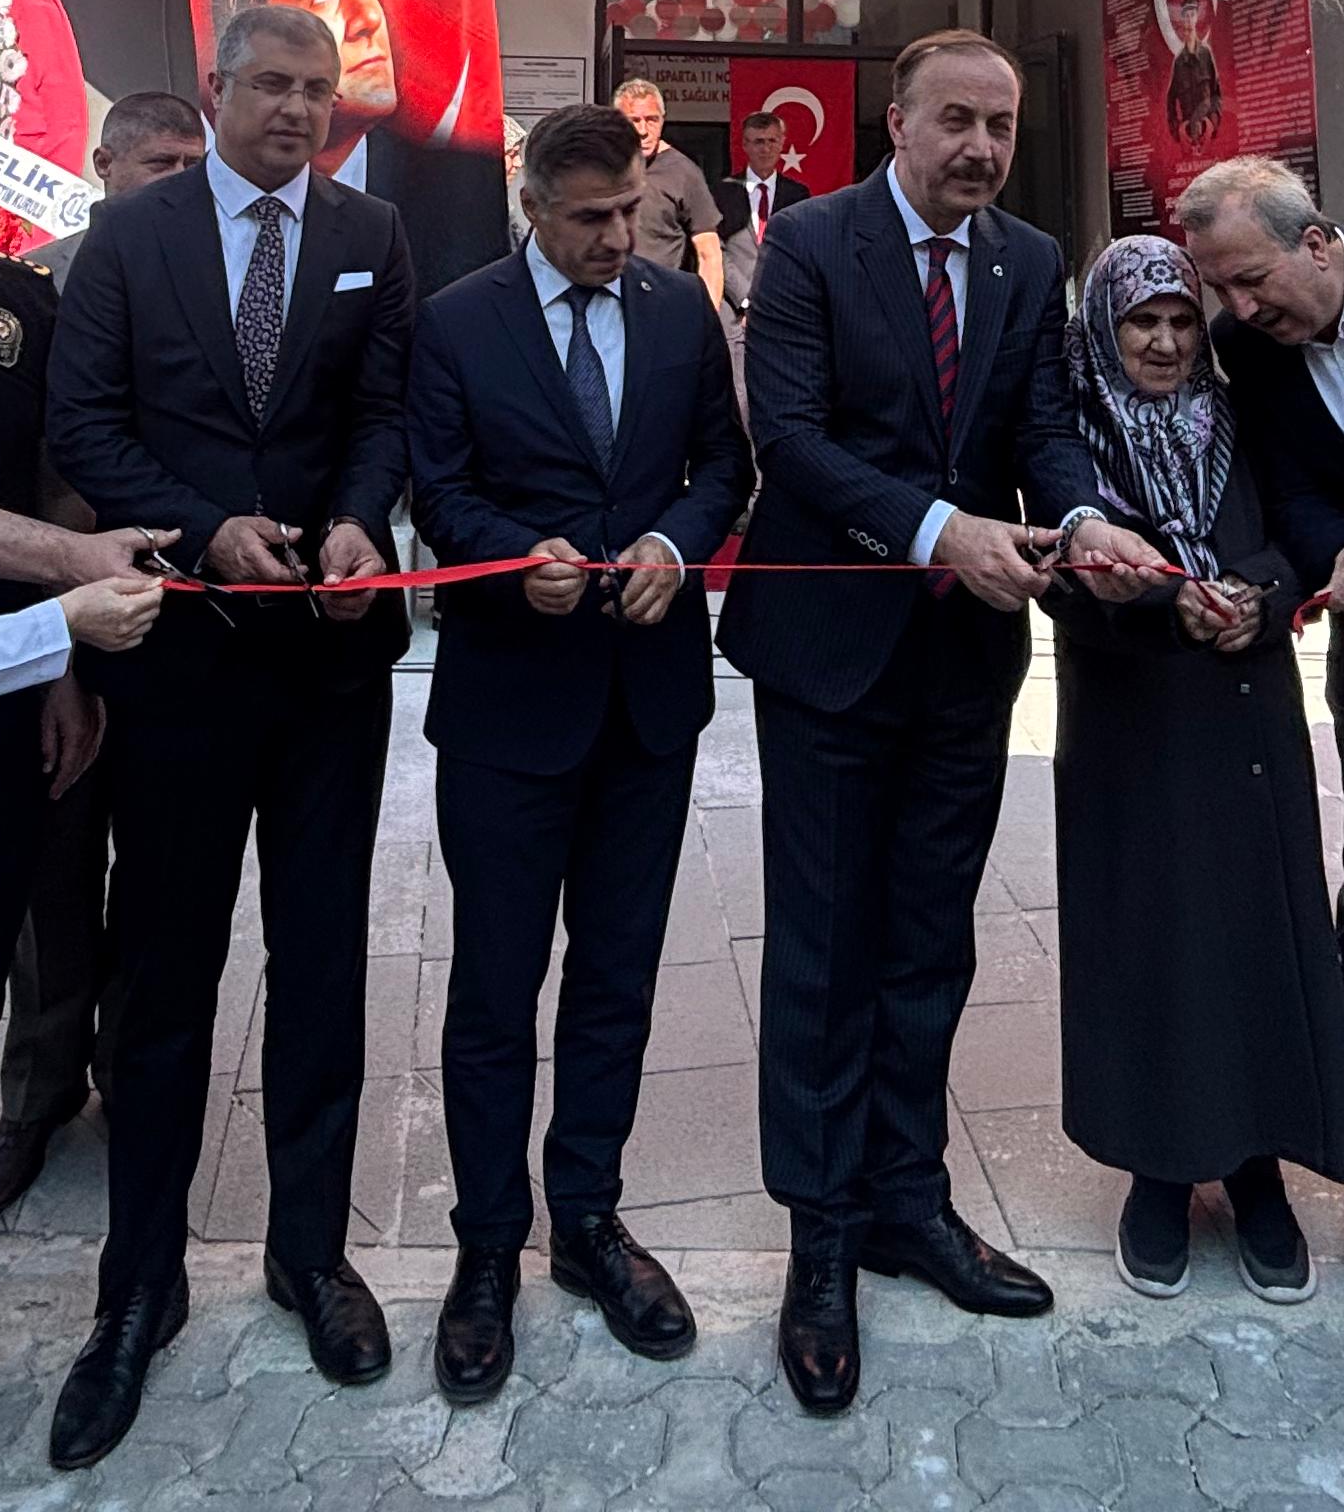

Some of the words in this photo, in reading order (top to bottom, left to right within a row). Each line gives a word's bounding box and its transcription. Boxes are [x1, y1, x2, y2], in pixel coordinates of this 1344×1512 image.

[656, 70, 697, 83] ISPARTA
[716, 71, 731, 84] NO
[682, 87, 719, 102] SAĞLIK
[721, 90, 730, 102] H
